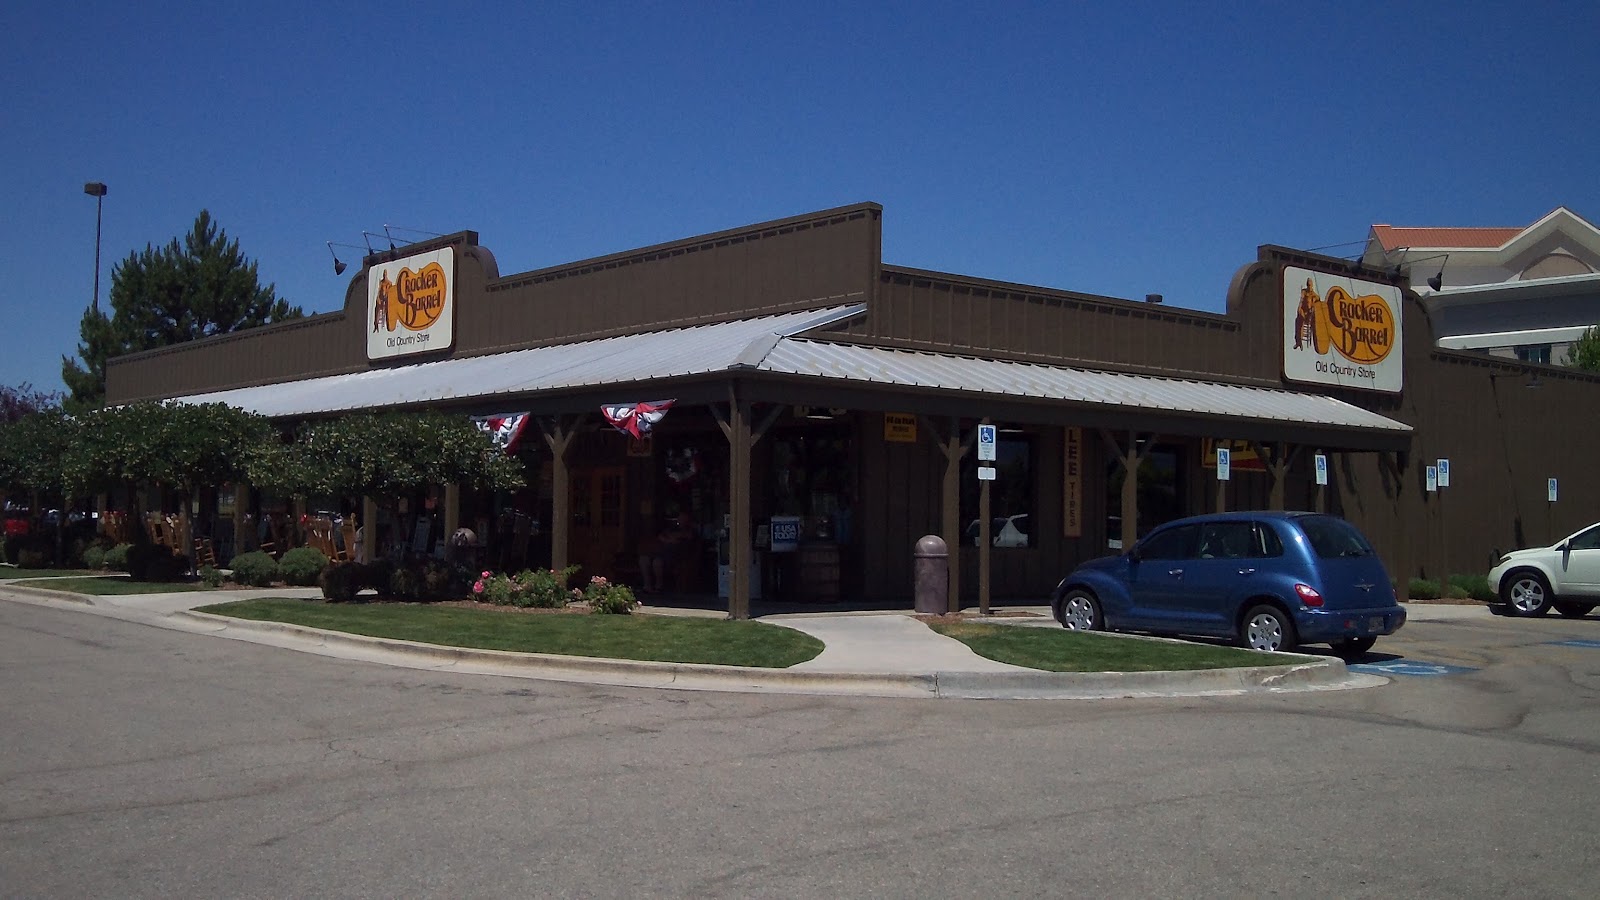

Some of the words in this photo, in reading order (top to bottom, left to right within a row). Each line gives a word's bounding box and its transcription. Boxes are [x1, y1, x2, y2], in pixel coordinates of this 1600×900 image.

[396, 270, 438, 305] Cracker
[405, 290, 441, 326] Barrel
[1326, 289, 1384, 328] Cracker
[386, 338, 395, 347] Old
[396, 333, 415, 346] Country
[416, 332, 430, 343] Store
[1342, 317, 1388, 356] Barrel
[1315, 360, 1328, 373] Old
[1329, 362, 1357, 378] Country
[1357, 366, 1376, 379] Store
[1068, 429, 1077, 475] LEE
[774, 531, 797, 540] TODAY
[781, 524, 796, 533] USA
